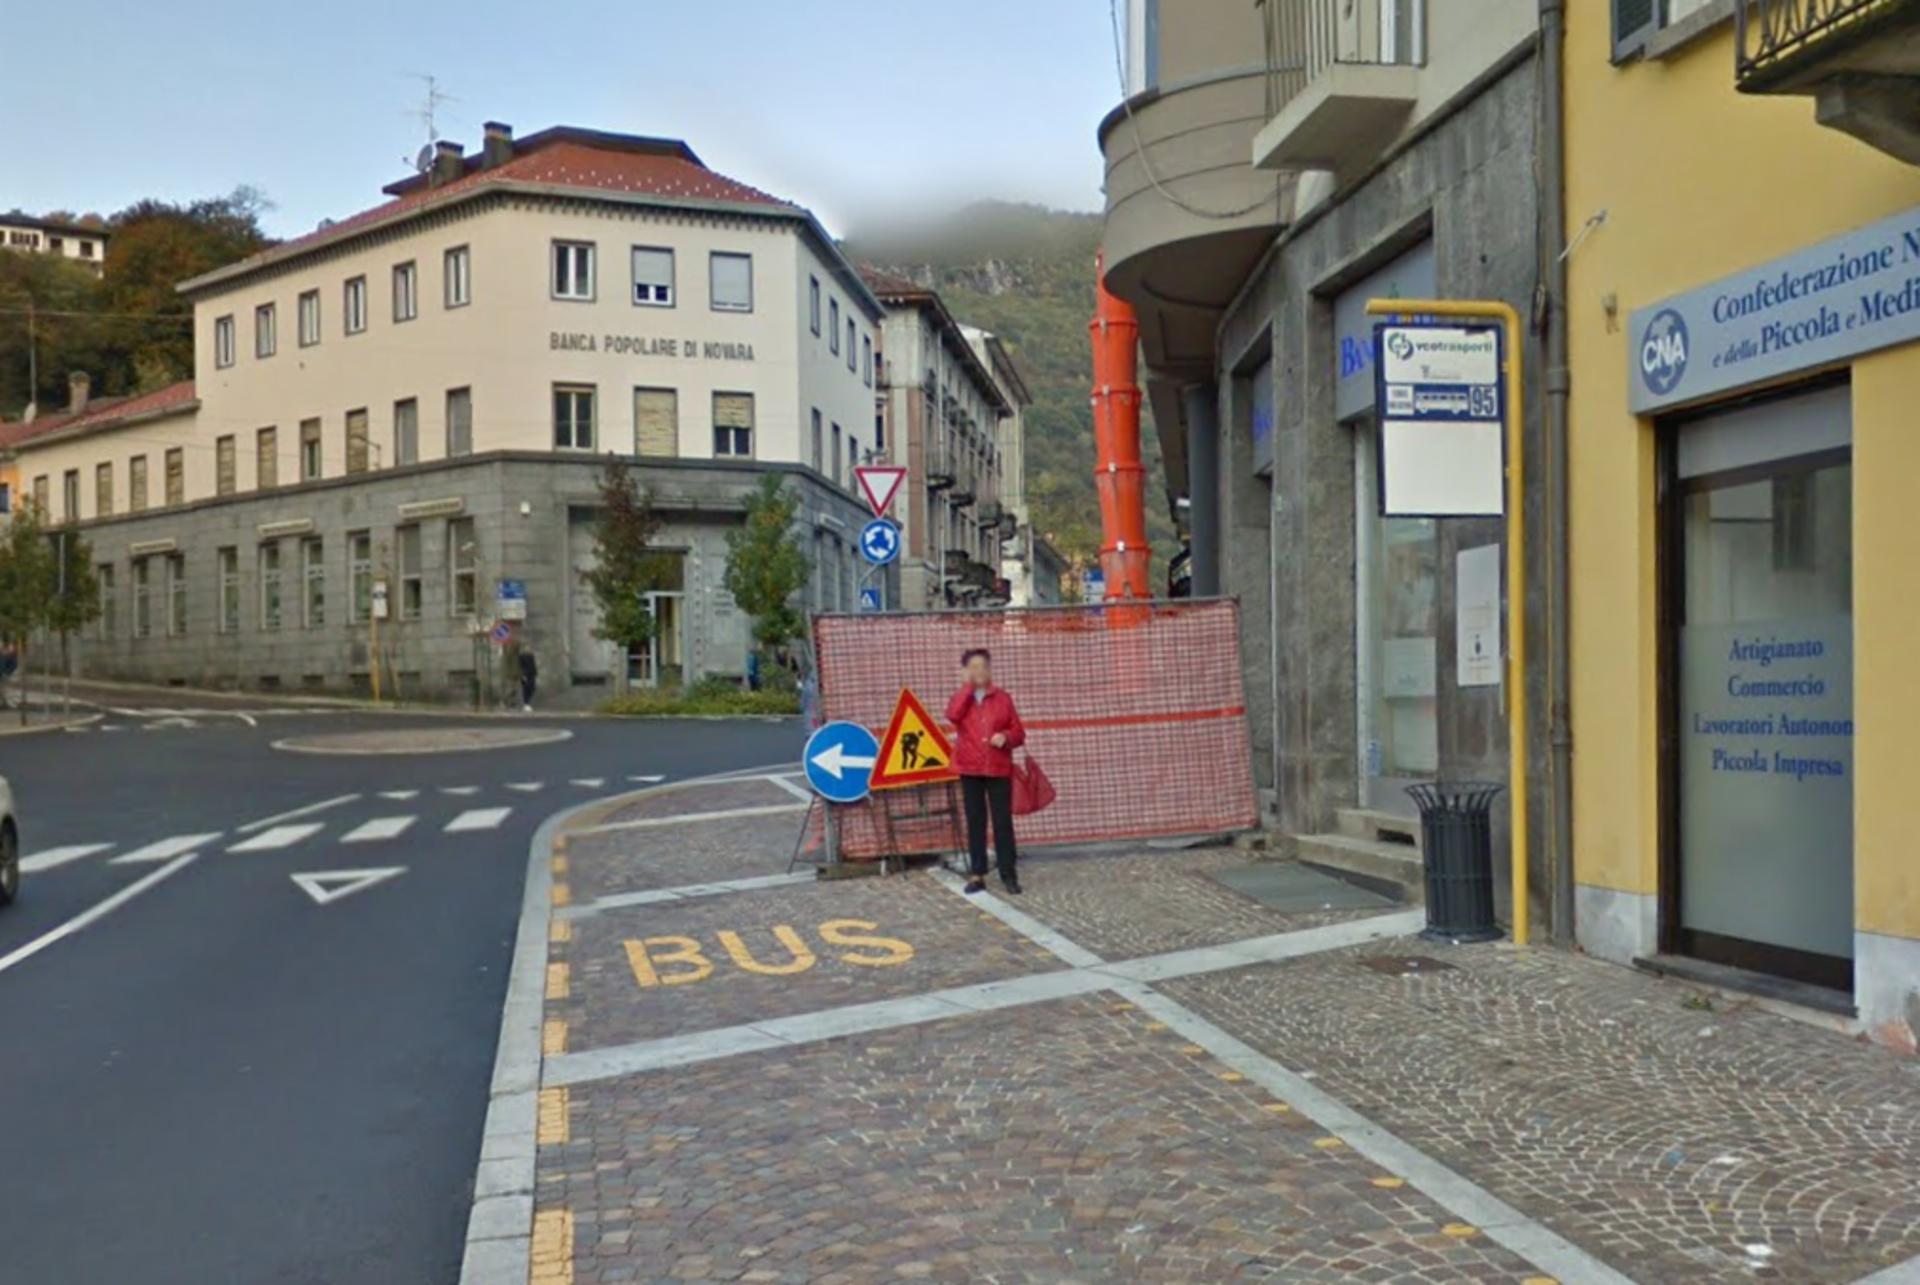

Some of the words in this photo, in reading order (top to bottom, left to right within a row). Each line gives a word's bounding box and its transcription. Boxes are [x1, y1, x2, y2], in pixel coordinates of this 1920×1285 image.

[1712, 245, 1894, 324] Confederazione
[550, 331, 597, 351] BANCA
[604, 335, 678, 357] POPOLARE
[684, 340, 697, 358] DI
[703, 341, 755, 361] NOVARA
[1642, 331, 1686, 373] CNA
[1713, 353, 1721, 368] e
[1724, 340, 1758, 366] della
[1760, 305, 1840, 354] Piccola
[1845, 314, 1856, 331] e
[1471, 386, 1495, 415] 95
[1729, 637, 1824, 667] Artigianato
[1728, 673, 1825, 697] Commercio
[1694, 713, 1773, 735] Lavoratori
[1712, 748, 1767, 773] Piccola
[1774, 752, 1843, 782] Impresa
[624, 918, 915, 987] BUS
